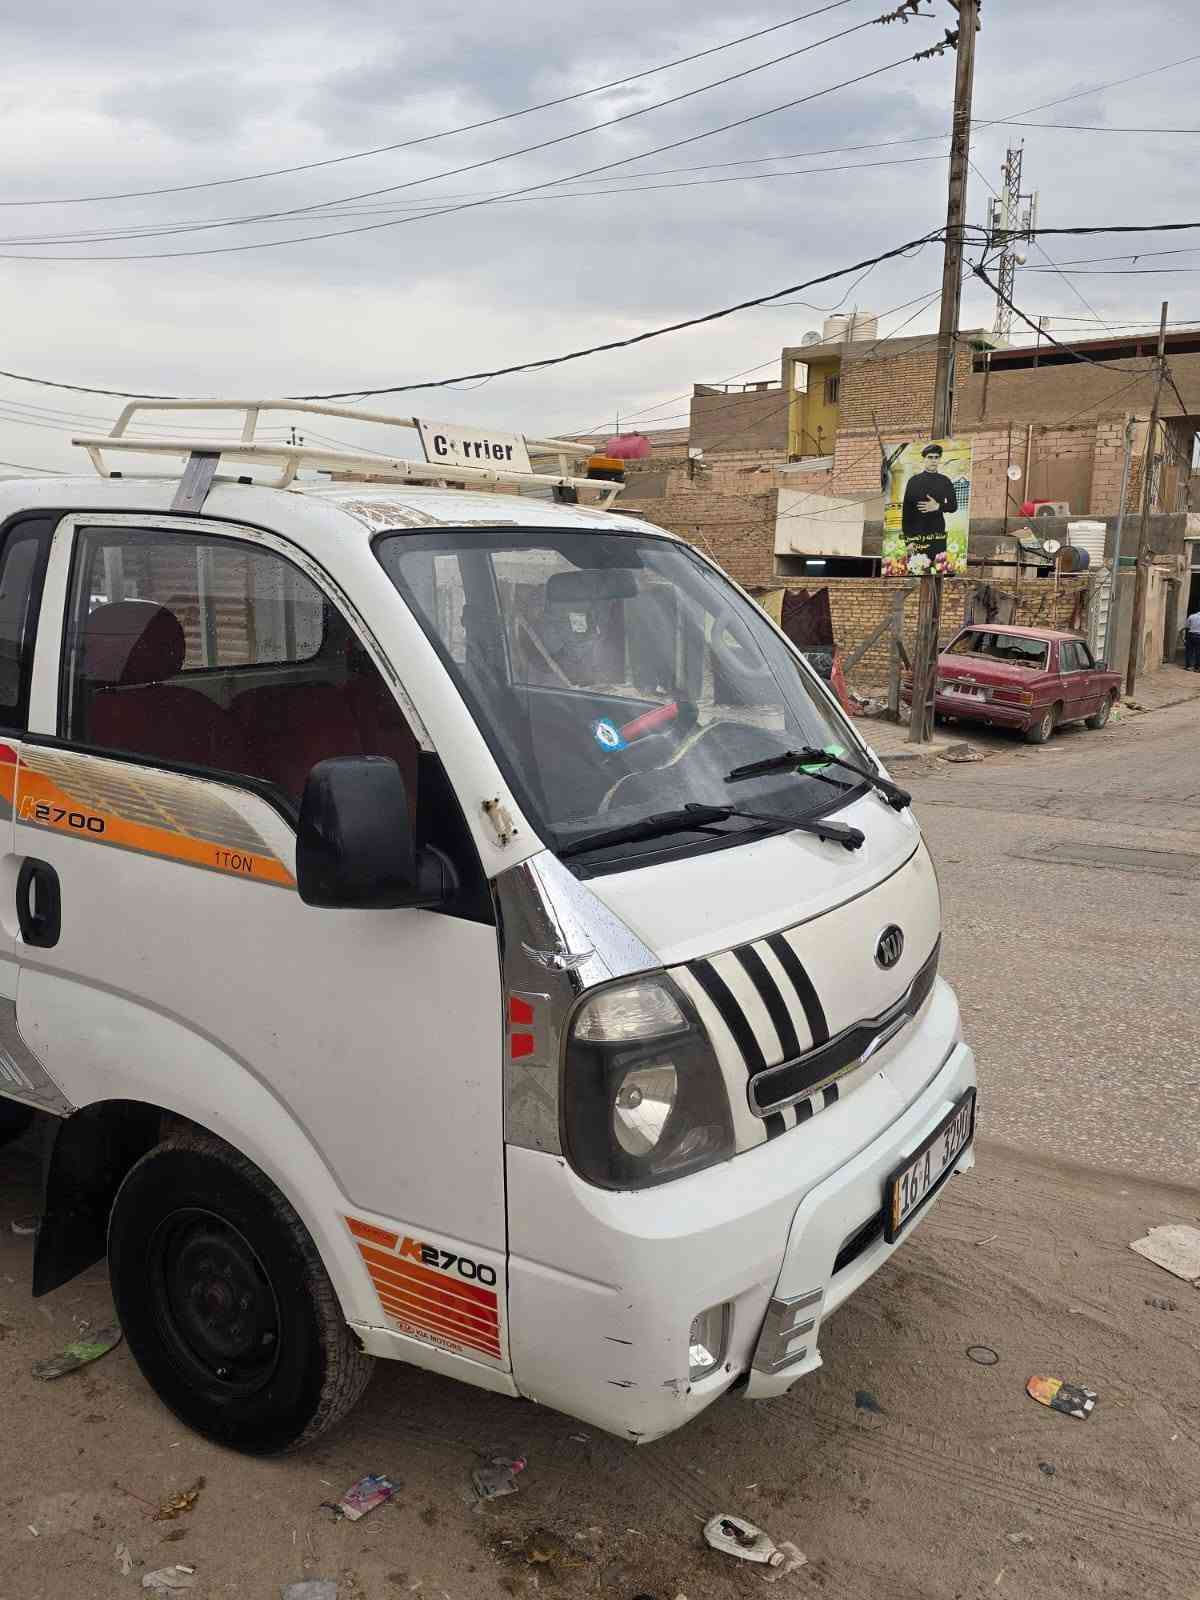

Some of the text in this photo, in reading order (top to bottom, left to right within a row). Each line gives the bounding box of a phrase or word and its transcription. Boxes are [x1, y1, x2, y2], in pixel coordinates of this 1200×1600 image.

[433, 434, 513, 461] Crrier
[18, 795, 105, 833] K2700
[901, 1159, 919, 1217] 16
[922, 1149, 931, 1193] A
[400, 1236, 497, 1286] K2700
